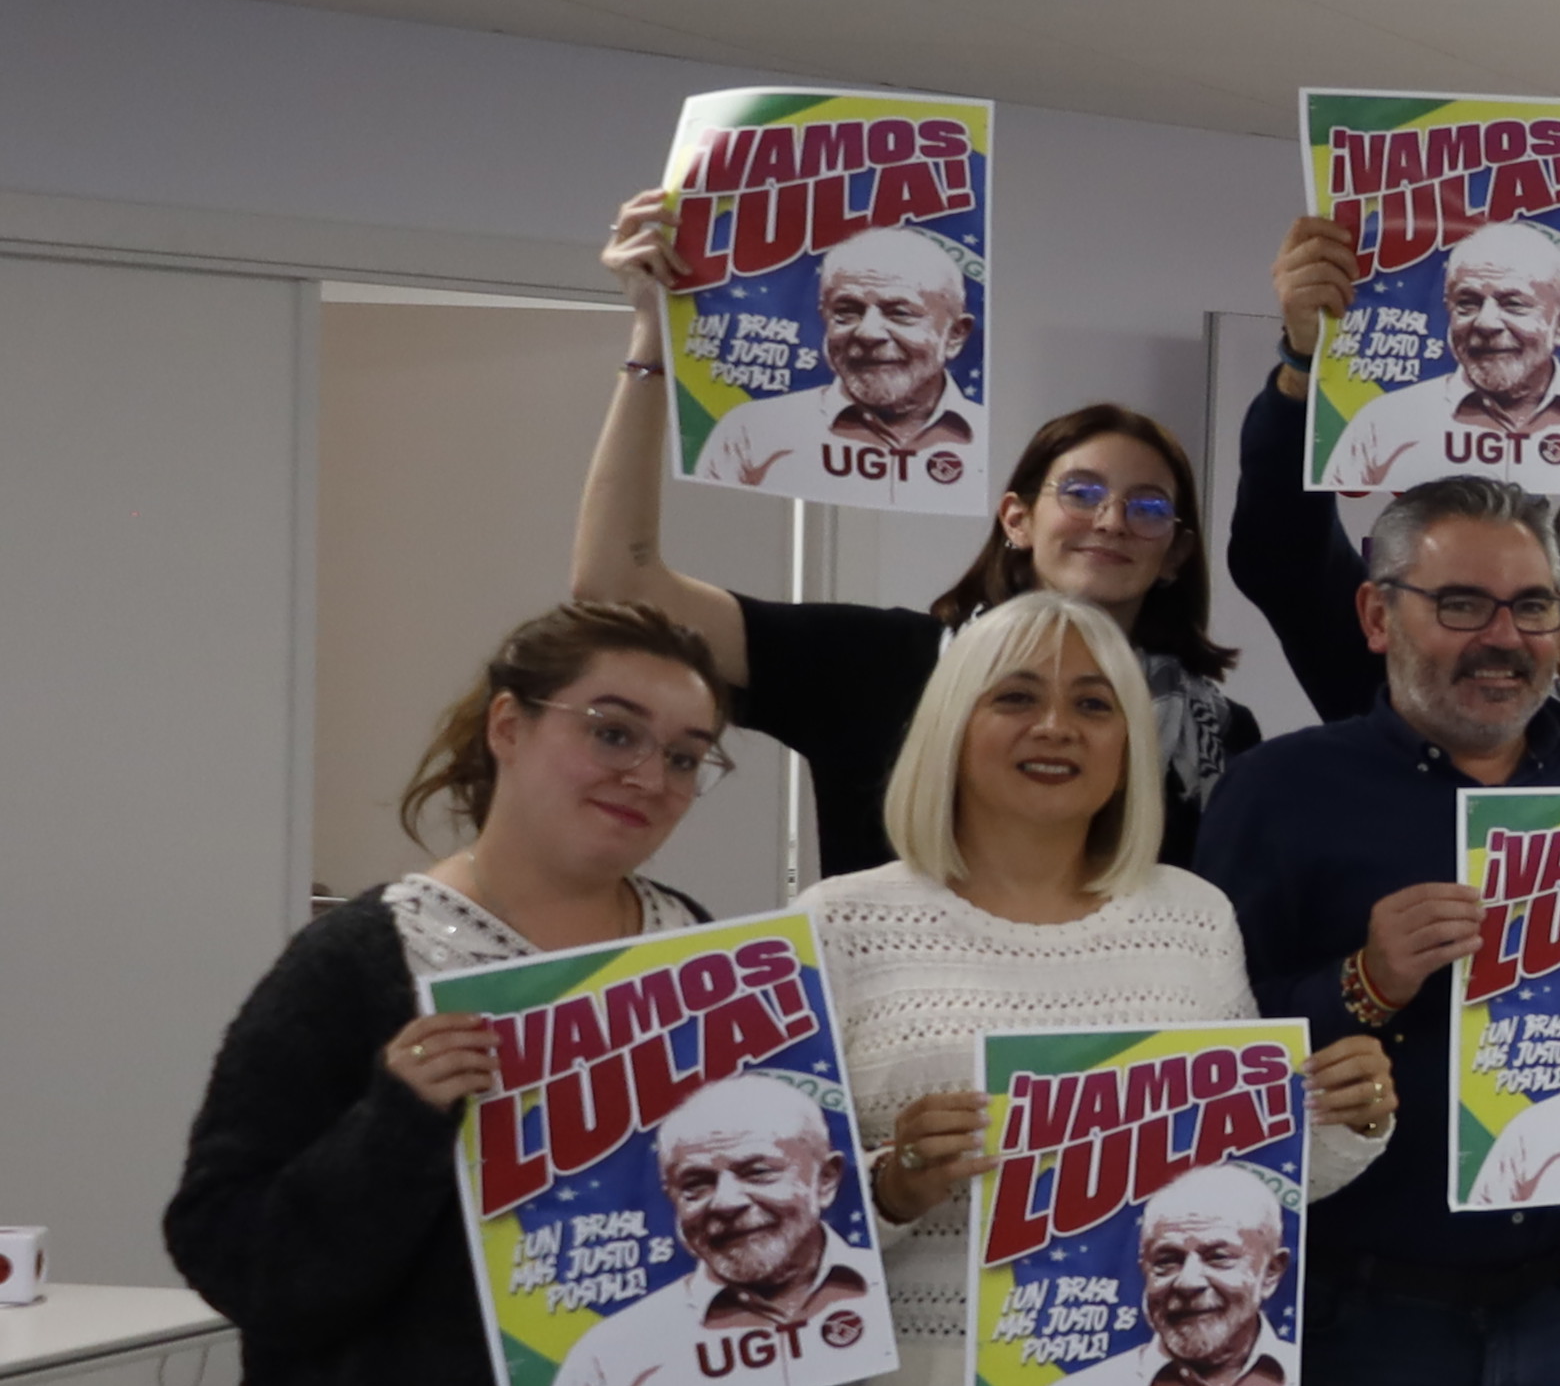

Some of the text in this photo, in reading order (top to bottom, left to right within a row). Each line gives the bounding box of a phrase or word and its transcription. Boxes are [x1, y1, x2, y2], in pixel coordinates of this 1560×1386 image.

[674, 158, 974, 289] LULA!
[821, 444, 917, 481] UGT
[1444, 431, 1531, 464] UGT
[481, 980, 817, 1212] LULA!
[1003, 1042, 1294, 1151] ¡VAMOS
[988, 1081, 1299, 1262] LULA!
[1041, 1304, 1109, 1335] JUSTO
[1054, 1275, 1120, 1305] BRASIL
[694, 1319, 809, 1379] UGT
